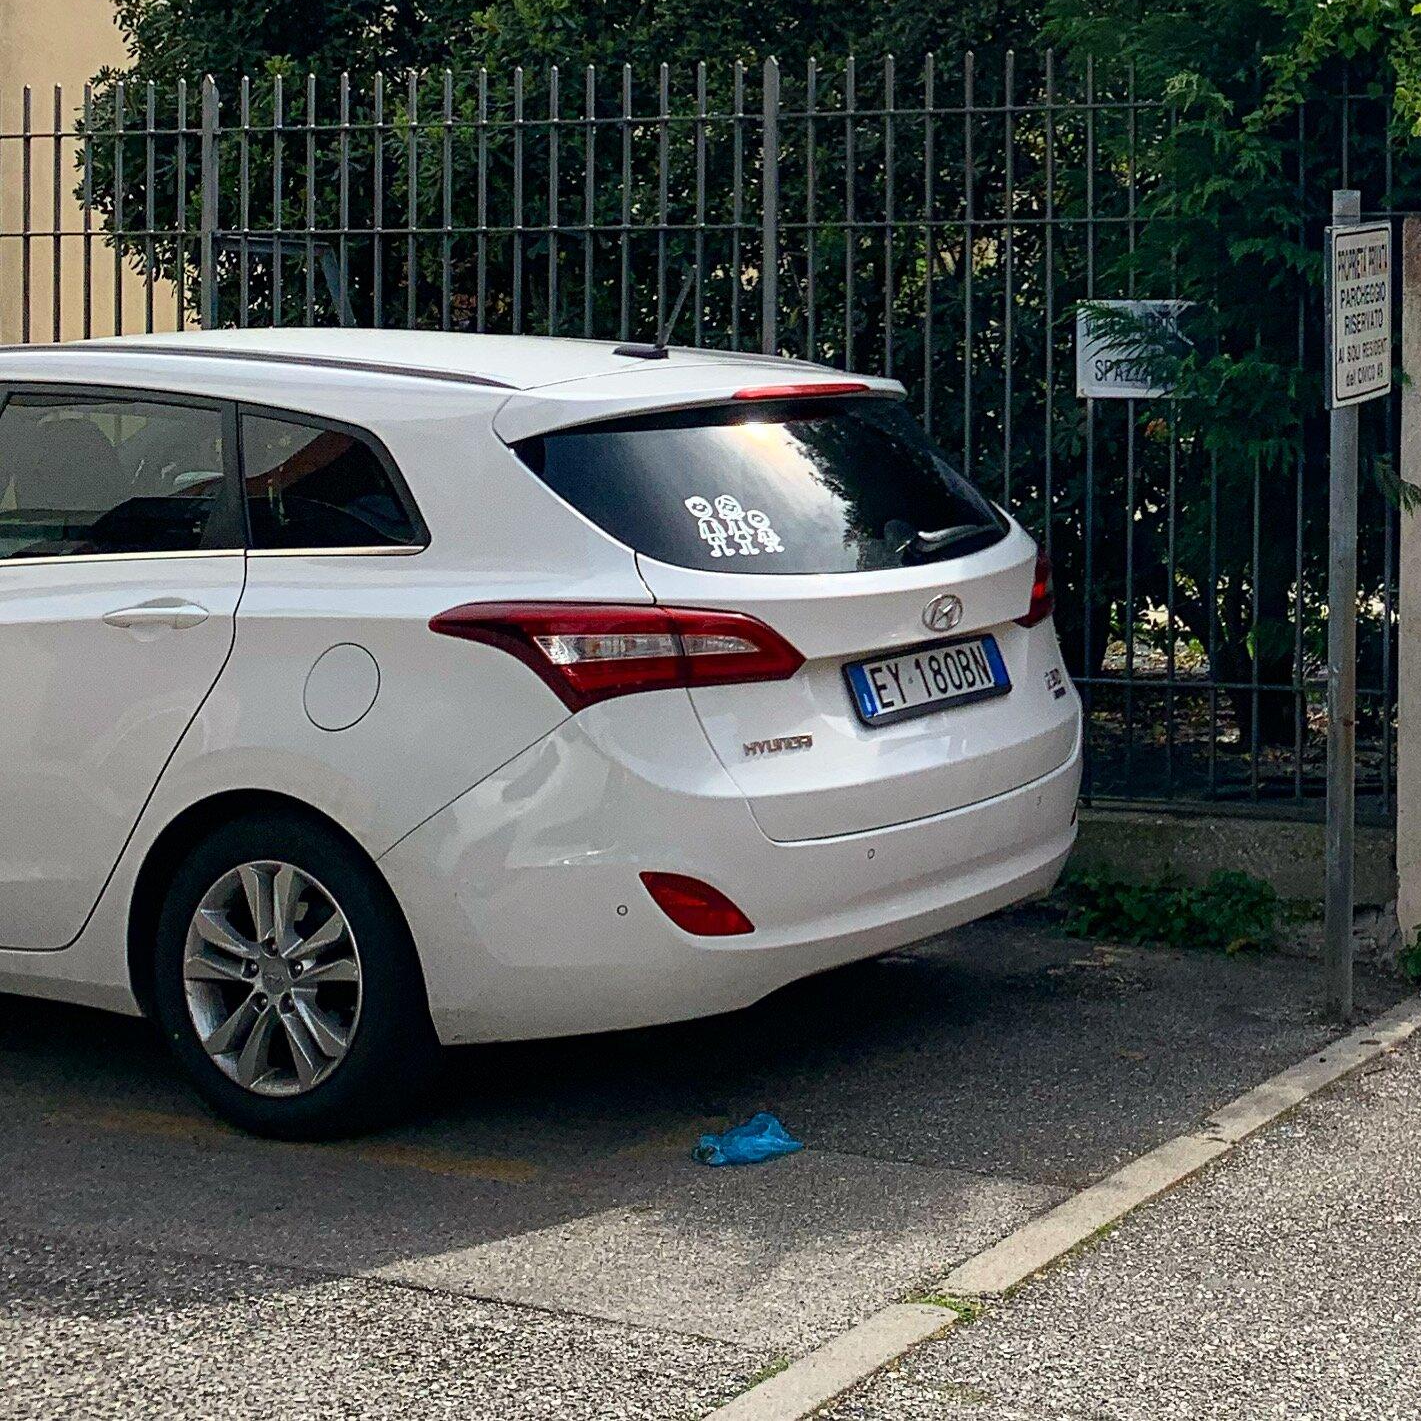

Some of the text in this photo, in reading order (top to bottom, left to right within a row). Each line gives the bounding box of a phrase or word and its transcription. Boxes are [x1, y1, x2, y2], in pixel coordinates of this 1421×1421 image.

[1341, 281, 1387, 309] PARCHEGGIO
[1344, 307, 1384, 336] RISERVATO
[1347, 343, 1361, 363] SOLI
[869, 644, 993, 710] EY 180BN
[742, 733, 814, 757] HYUNDAI
